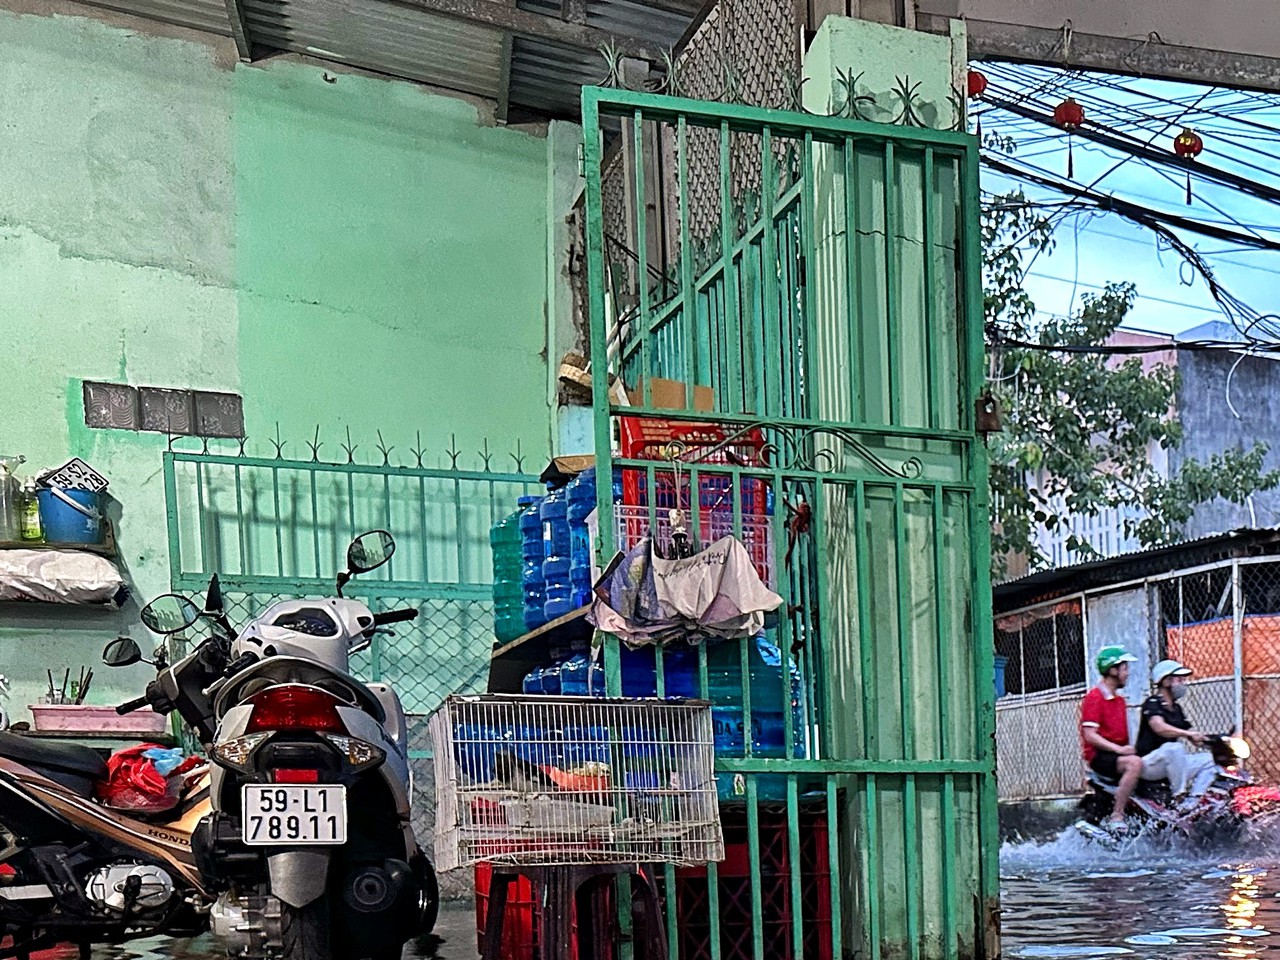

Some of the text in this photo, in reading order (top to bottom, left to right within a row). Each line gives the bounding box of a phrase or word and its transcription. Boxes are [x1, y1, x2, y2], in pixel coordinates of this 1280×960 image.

[260, 789, 328, 813] 59-L1
[148, 829, 192, 847] HOND
[250, 815, 337, 840] 789.11
